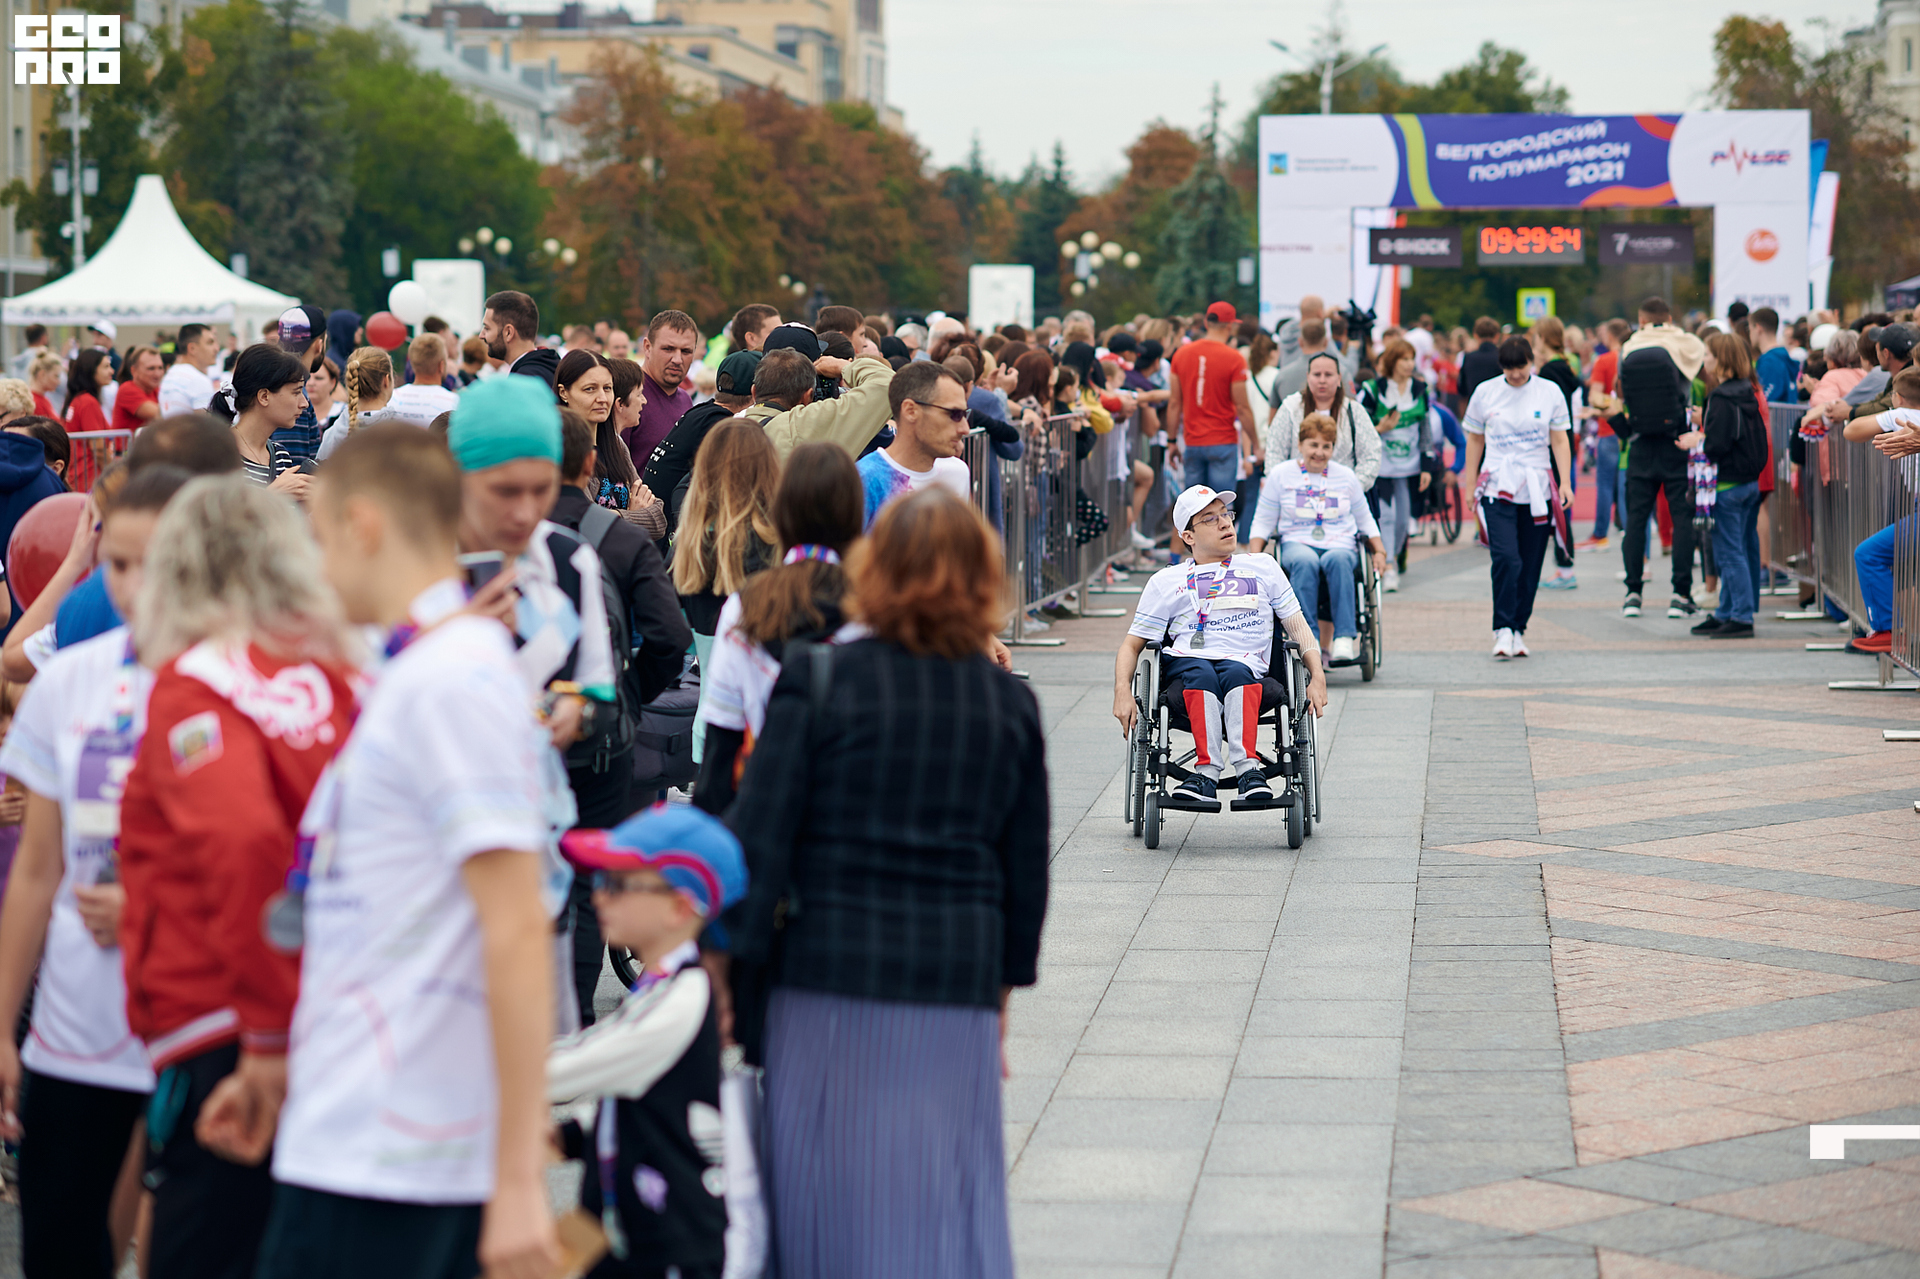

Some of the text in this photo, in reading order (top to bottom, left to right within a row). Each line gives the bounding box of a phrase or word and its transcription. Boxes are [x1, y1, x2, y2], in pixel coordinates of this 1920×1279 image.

[1435, 119, 1608, 161] БЕЛГОРОДСКИЙ
[1468, 142, 1631, 182] ПОЛУМАРАФОН
[1565, 160, 1626, 188] 2021
